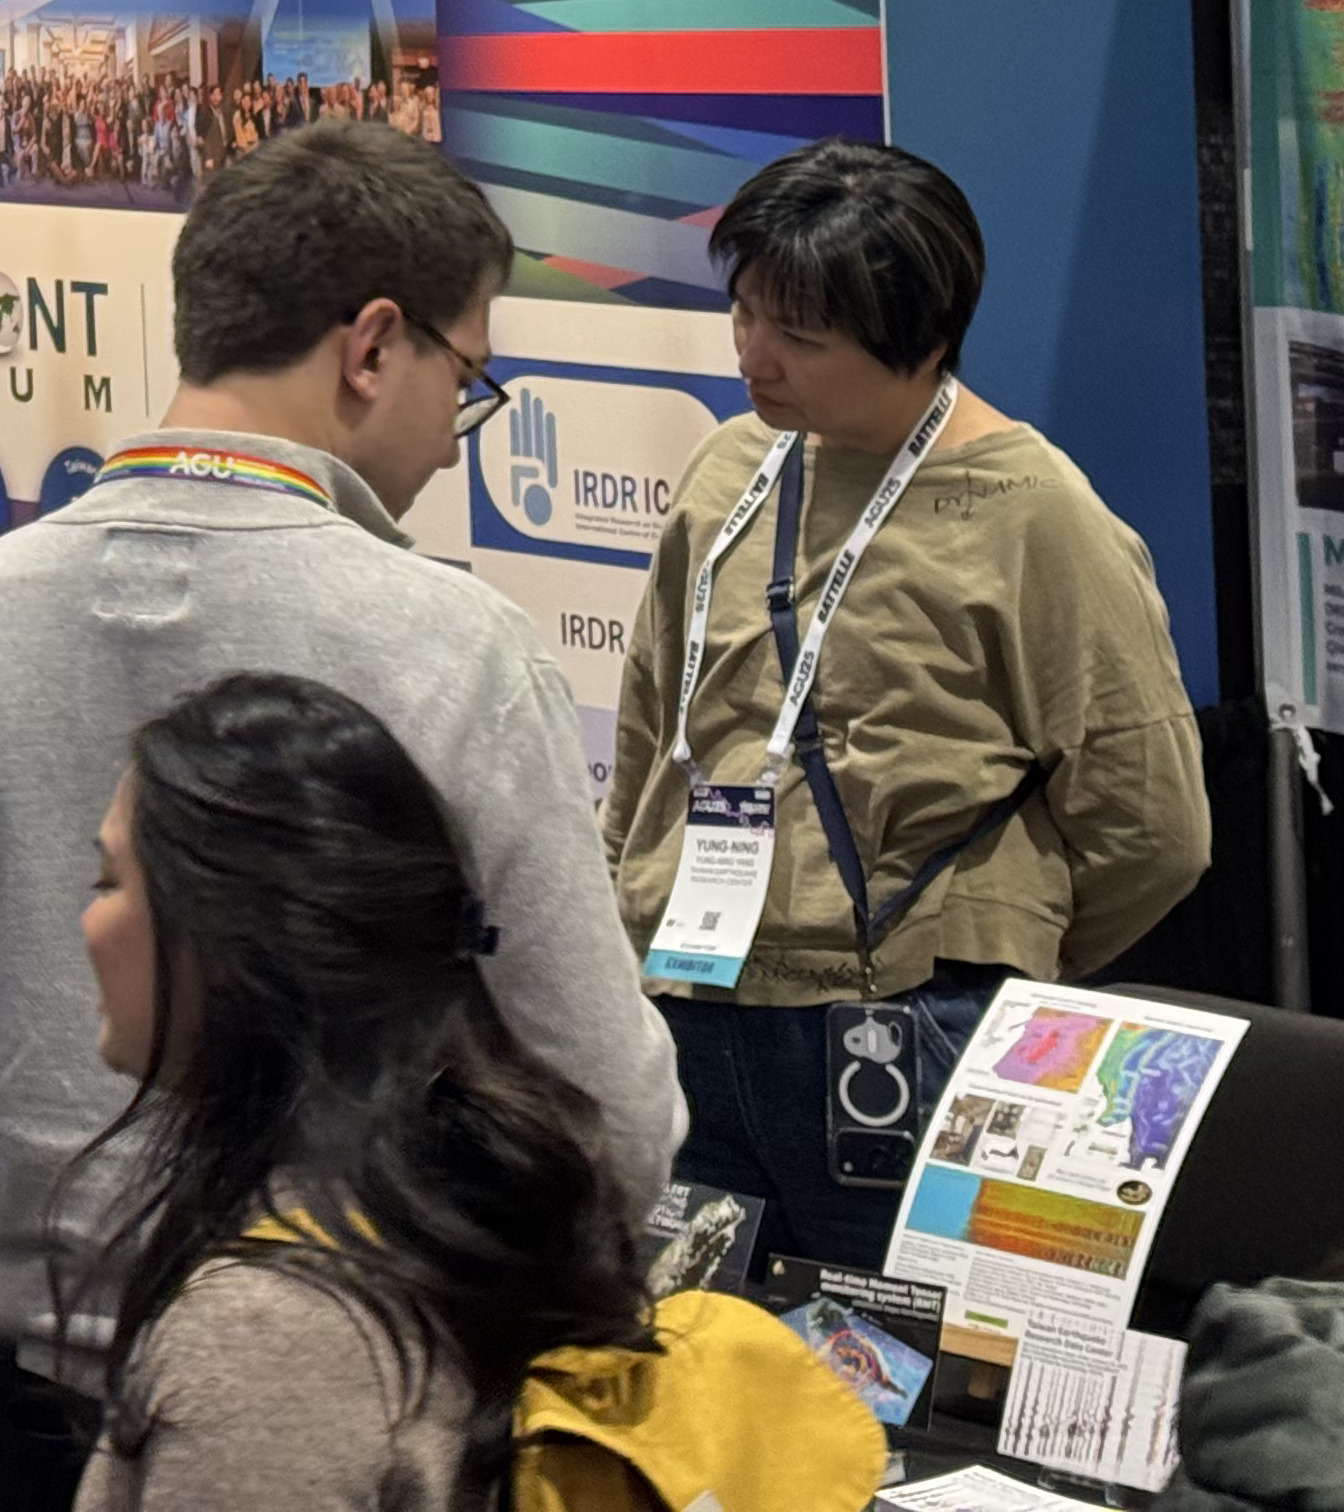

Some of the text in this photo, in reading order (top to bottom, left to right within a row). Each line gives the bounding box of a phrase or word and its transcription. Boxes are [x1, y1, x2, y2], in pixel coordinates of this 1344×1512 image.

[168, 451, 237, 480] AGU
[574, 468, 672, 516] IRDR IC
[862, 477, 903, 530] AGU25
[816, 548, 856, 625] BATTELLE
[561, 611, 626, 655] IRDR
[788, 649, 815, 707] AGU25
[696, 838, 760, 855] YUNG-NING
